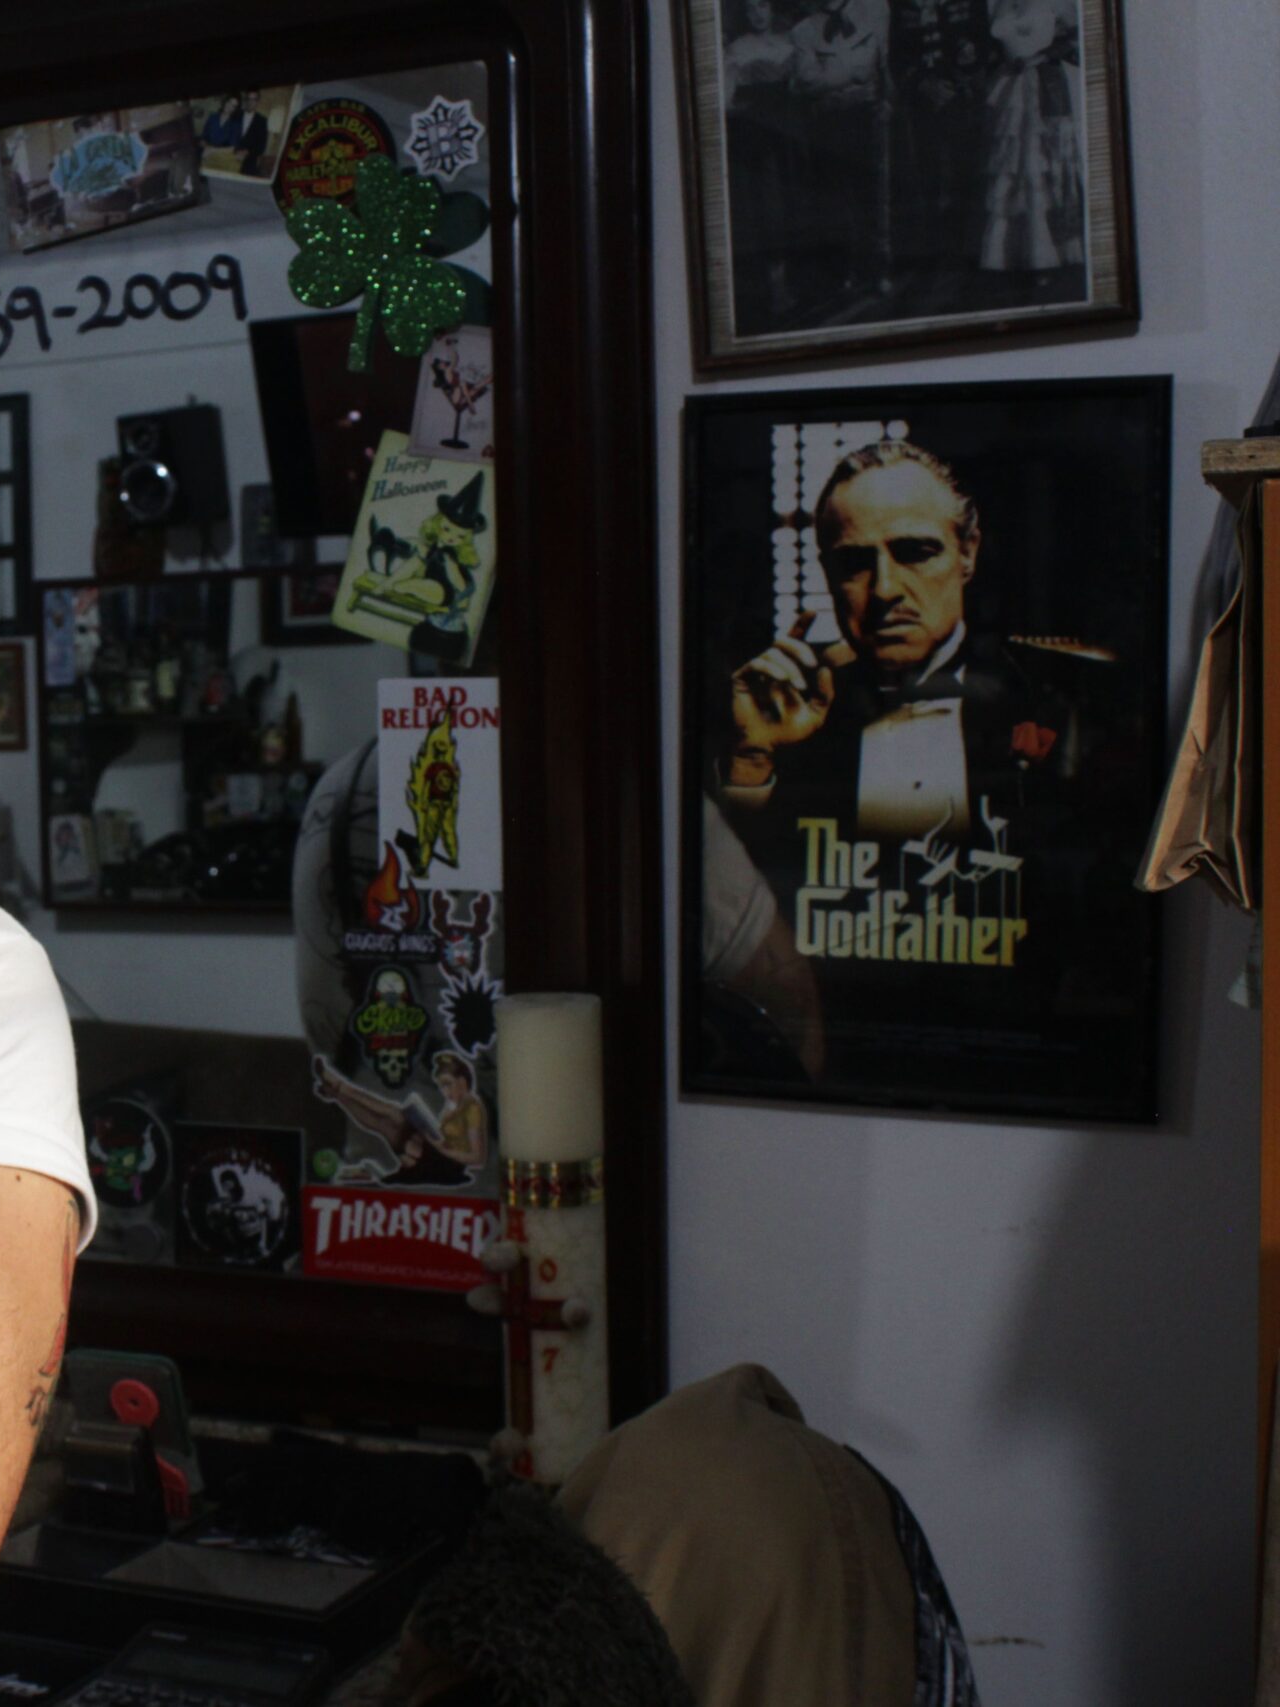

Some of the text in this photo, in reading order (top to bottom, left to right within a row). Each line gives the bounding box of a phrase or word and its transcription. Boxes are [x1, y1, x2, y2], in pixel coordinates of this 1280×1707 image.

[286, 113, 380, 162] EXCALIBUR
[372, 478, 448, 501] Halloween
[413, 686, 467, 708] BAD
[381, 707, 501, 729] RELIGION
[796, 816, 881, 889] The
[795, 885, 1030, 967] Godfather
